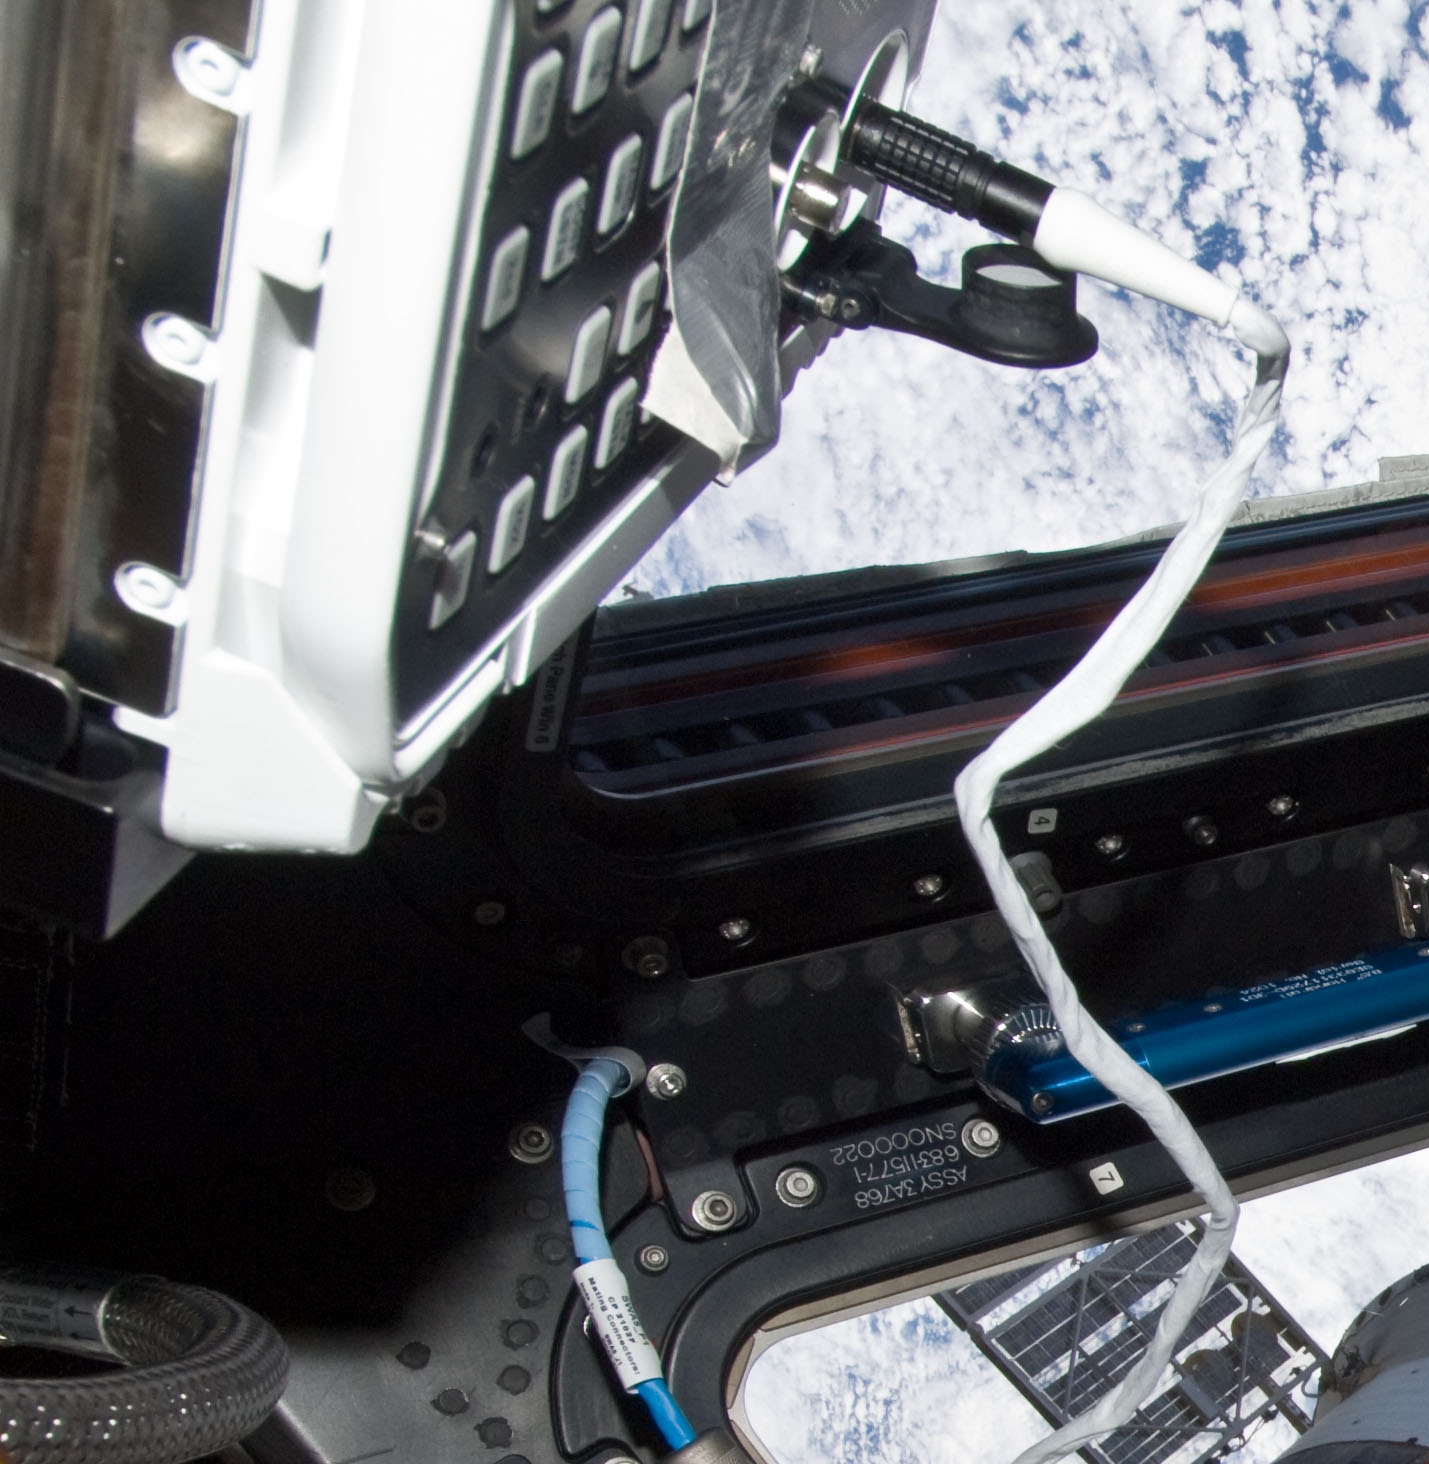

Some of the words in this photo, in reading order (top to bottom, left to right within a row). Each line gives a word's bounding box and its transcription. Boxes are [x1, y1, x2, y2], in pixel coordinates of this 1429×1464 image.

[538, 706, 556, 732] Win
[1033, 815, 1050, 826] 4
[854, 1144, 960, 1183] 683-11577-1
[1097, 1170, 1116, 1183] 7
[919, 1165, 969, 1192] ASSY
[854, 1179, 916, 1209] 3A768
